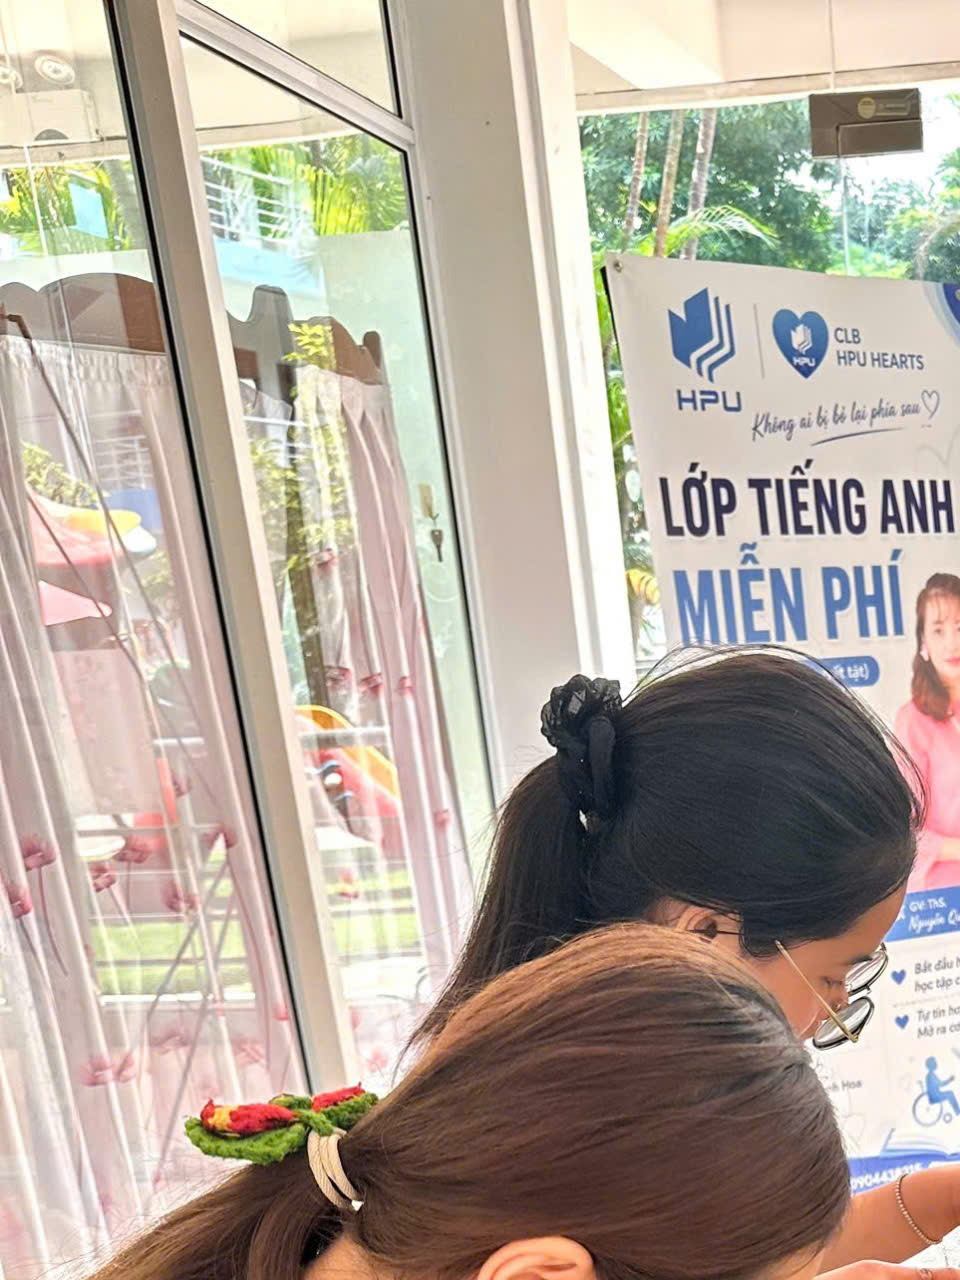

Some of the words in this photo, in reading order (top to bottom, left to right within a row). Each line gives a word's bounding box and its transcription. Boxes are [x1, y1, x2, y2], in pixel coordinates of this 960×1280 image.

[834, 327, 861, 345] CLB
[793, 356, 816, 369] HPU
[836, 350, 867, 367] HPU
[870, 352, 925, 371] HEARTS
[676, 389, 743, 413] HPU
[751, 411, 797, 442] Không
[800, 411, 813, 429] ai
[816, 405, 829, 430] bị
[850, 401, 868, 425] lại
[870, 397, 898, 427] phía
[900, 402, 921, 417] sau
[659, 461, 738, 537] LỚP
[748, 458, 868, 536] TIẾNG
[880, 478, 956, 535] ANH
[673, 541, 808, 646] MIỄN
[821, 548, 905, 641] PHÍ
[934, 956, 955, 972] đầu
[914, 980, 934, 995] học
[932, 1005, 946, 1019] tin
[935, 1024, 947, 1035] ra
